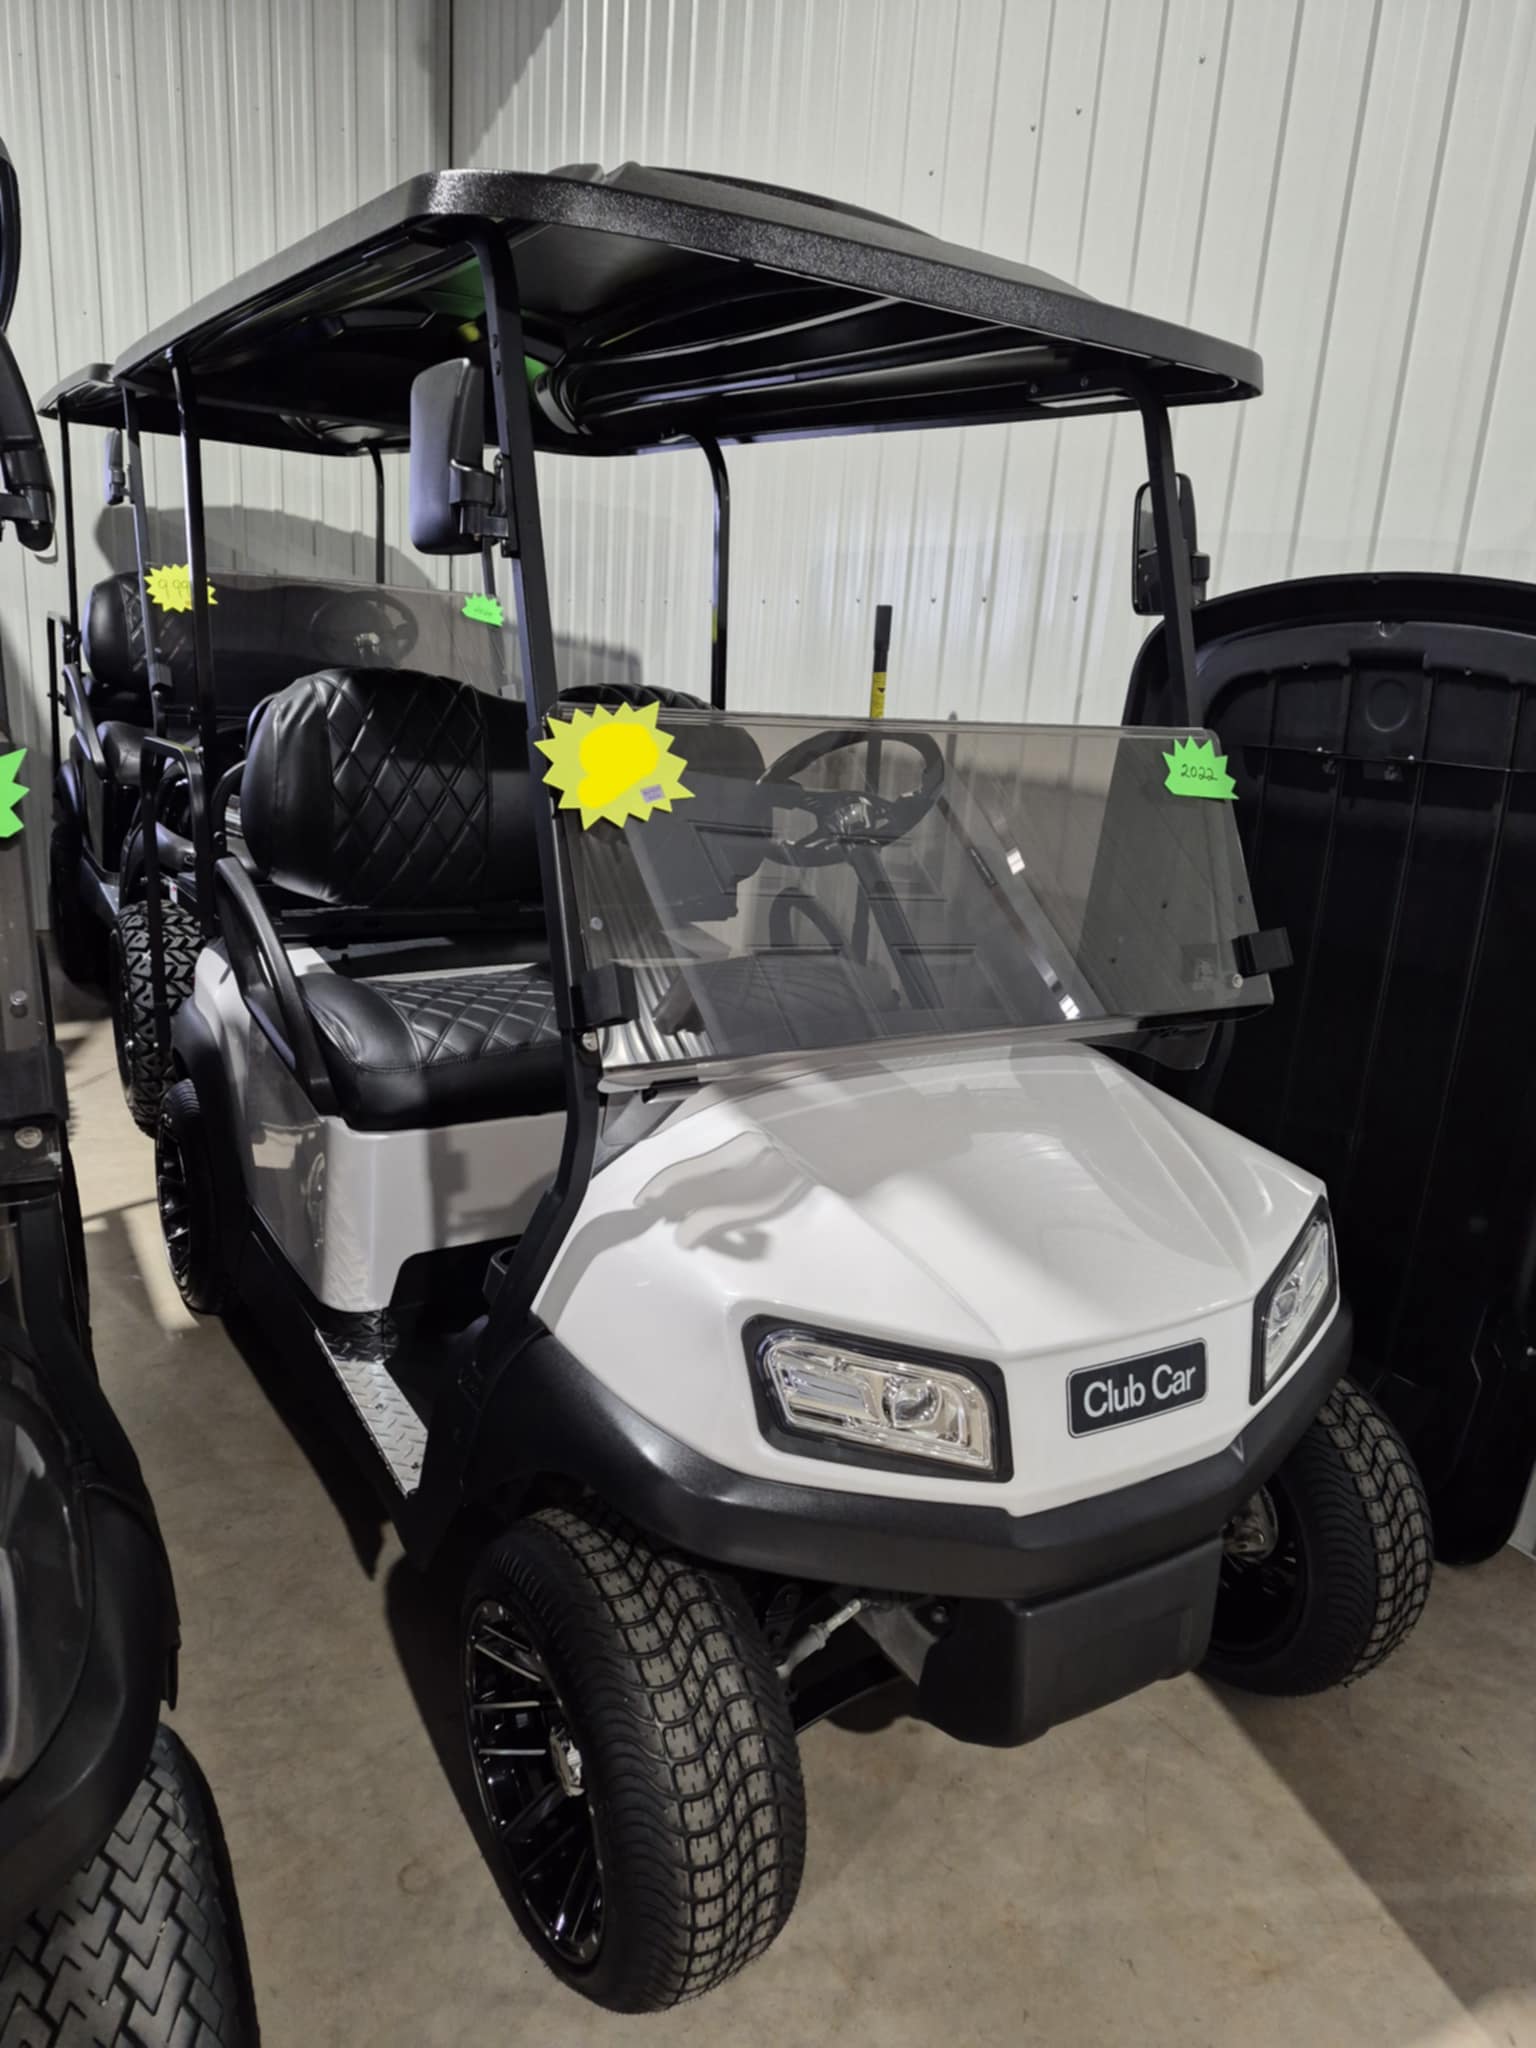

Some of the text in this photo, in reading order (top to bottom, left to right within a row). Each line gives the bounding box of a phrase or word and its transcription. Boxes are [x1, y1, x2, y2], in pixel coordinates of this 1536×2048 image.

[1181, 763, 1218, 781] 2022
[1083, 1364, 1196, 1418] Club Car
